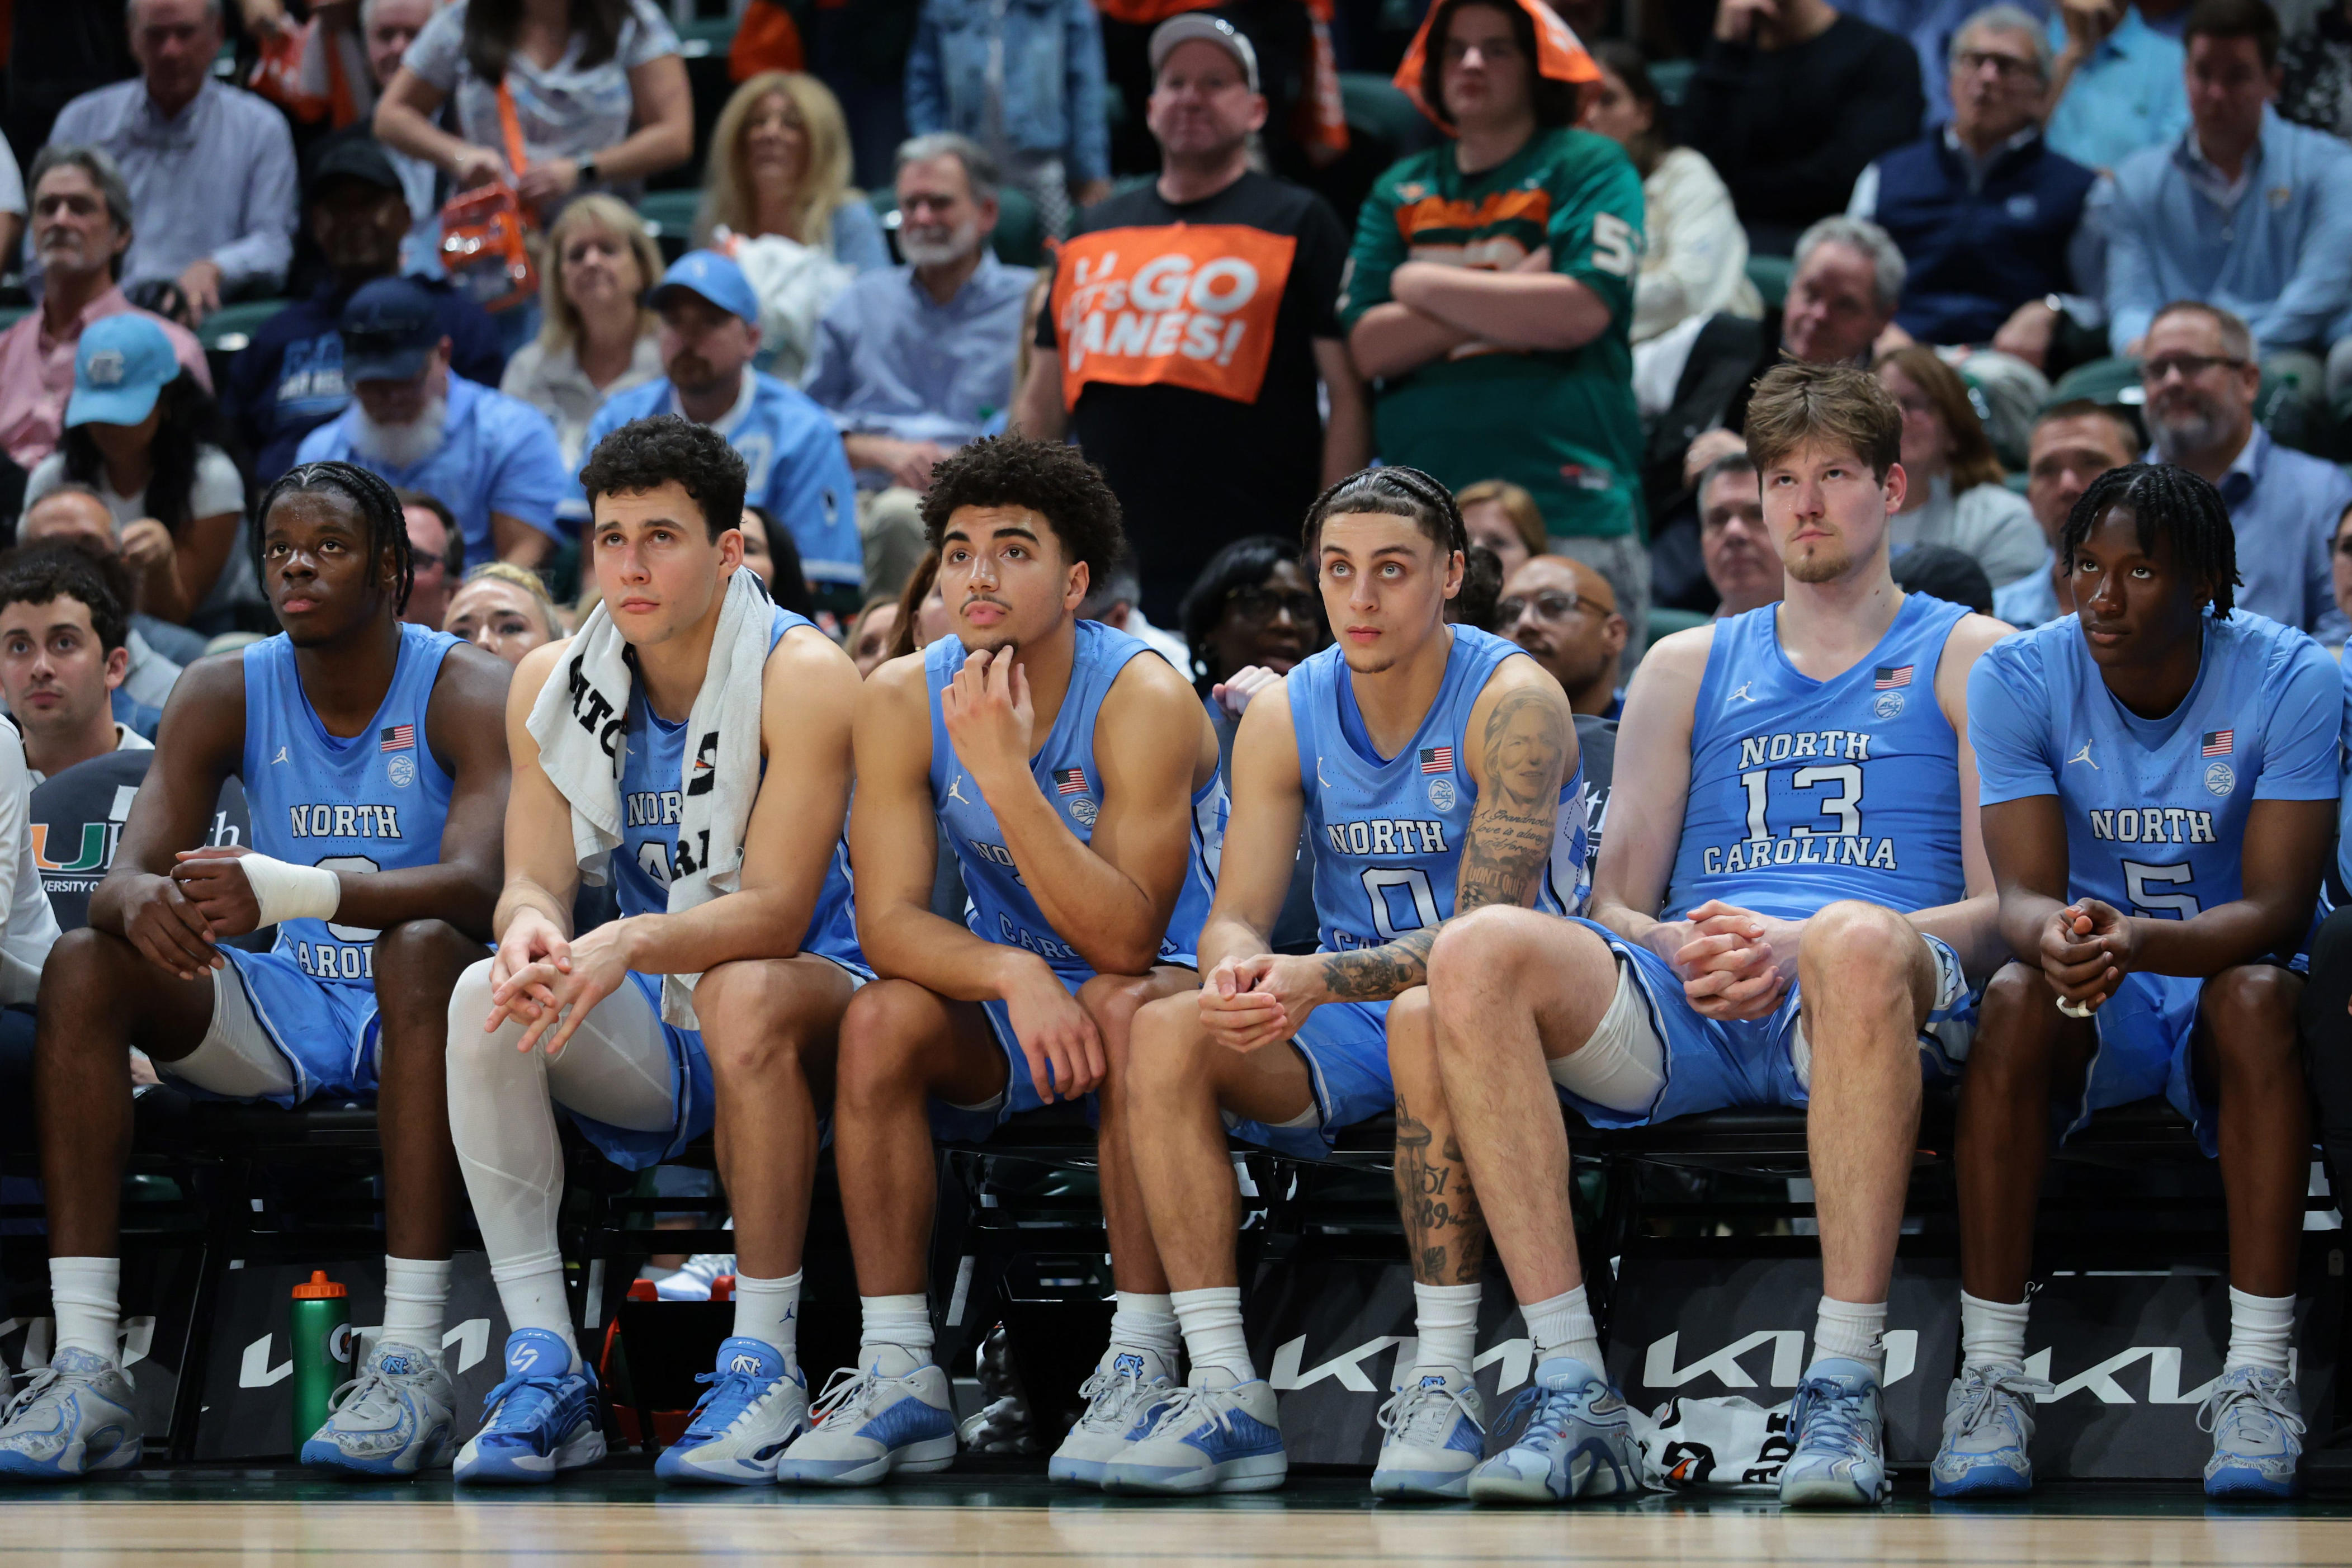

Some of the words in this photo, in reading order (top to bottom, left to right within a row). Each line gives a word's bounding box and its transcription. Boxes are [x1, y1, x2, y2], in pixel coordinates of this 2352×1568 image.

[1130, 253, 1258, 313] GO
[1069, 311, 1247, 373] ANES!
[1737, 729, 1871, 770] NORTH
[290, 804, 403, 838] NORTH
[1740, 762, 1864, 843] 13
[1326, 819, 1449, 854] NORTH
[2090, 808, 2217, 843] NORTH
[1703, 837, 1897, 875] CAROLINA
